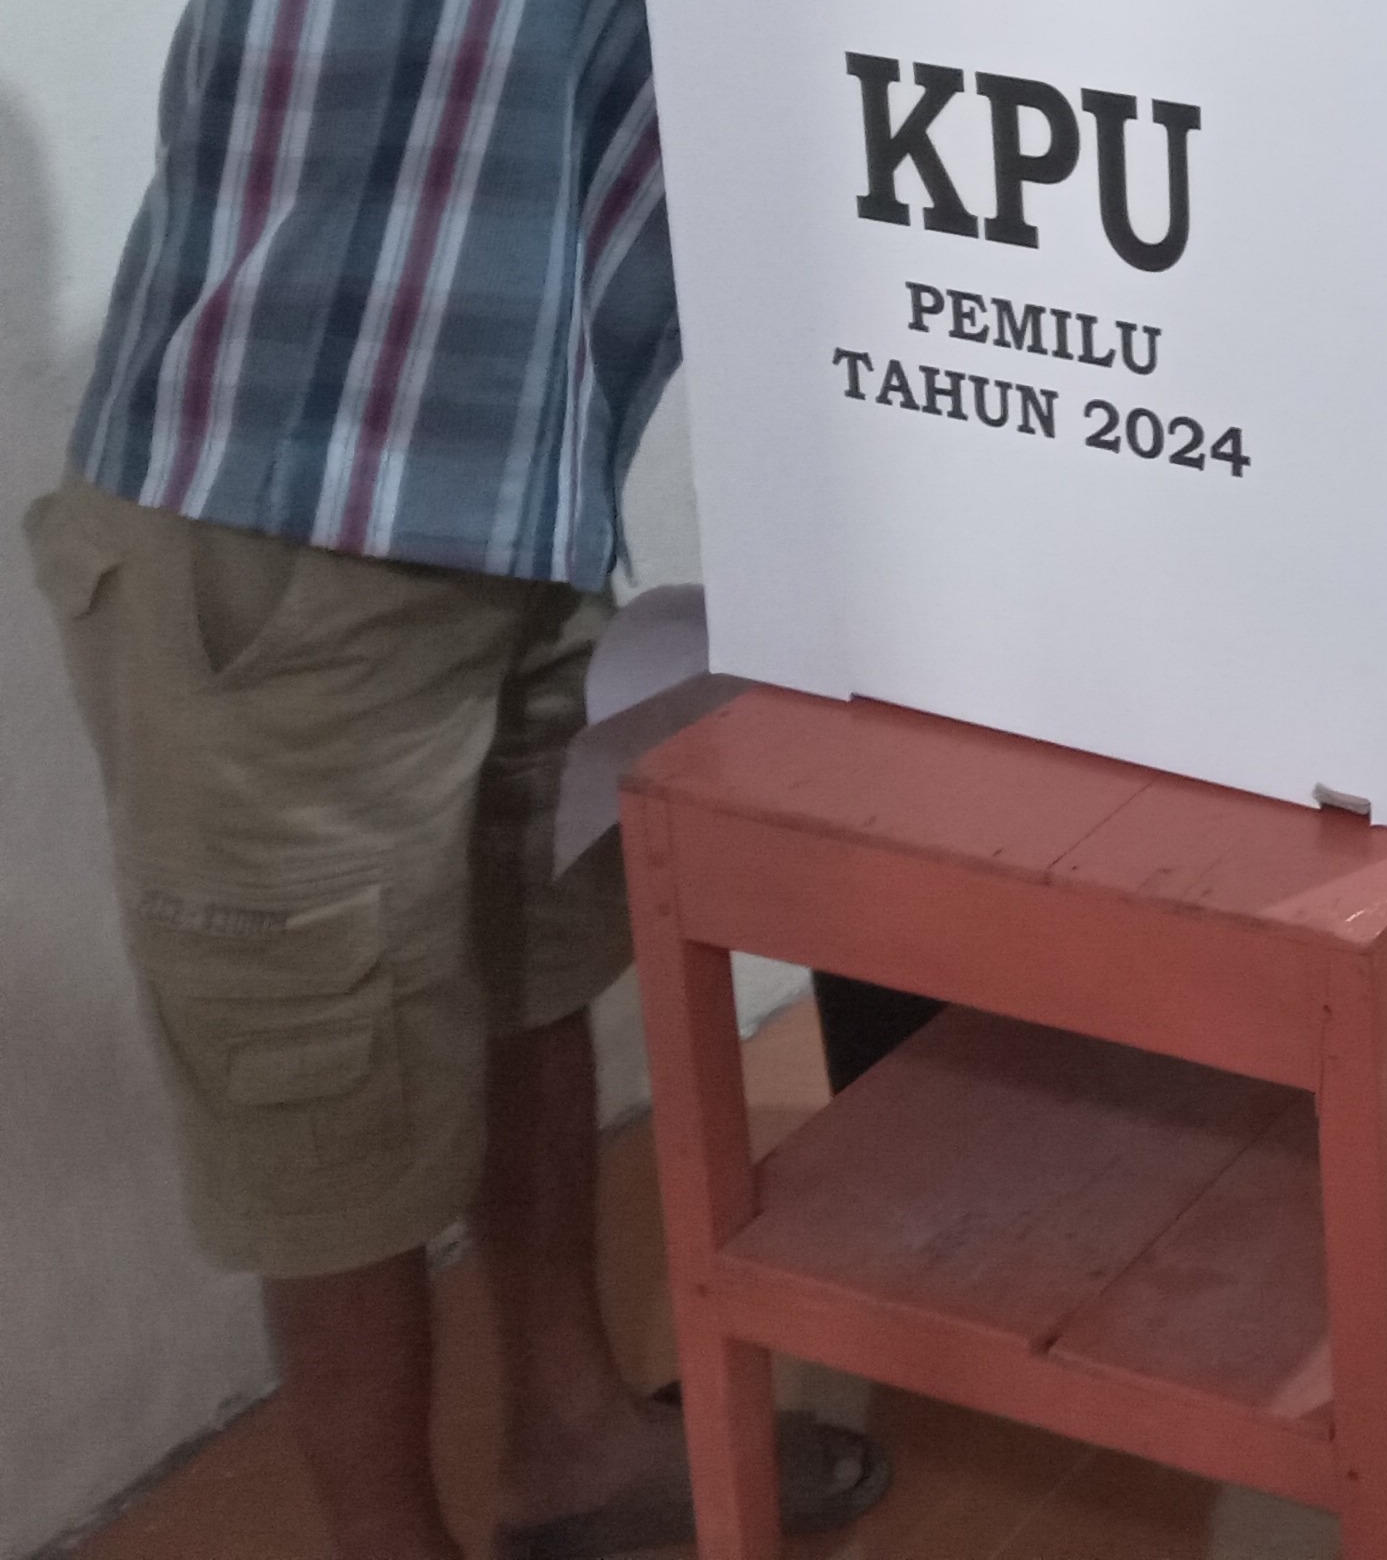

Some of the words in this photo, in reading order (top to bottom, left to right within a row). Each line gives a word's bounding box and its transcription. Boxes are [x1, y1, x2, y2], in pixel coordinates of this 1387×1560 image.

[845, 51, 1201, 273] KPU
[905, 281, 1163, 376] PEMILU
[833, 347, 1059, 439] TAHUN
[1083, 400, 1251, 479] 2024
